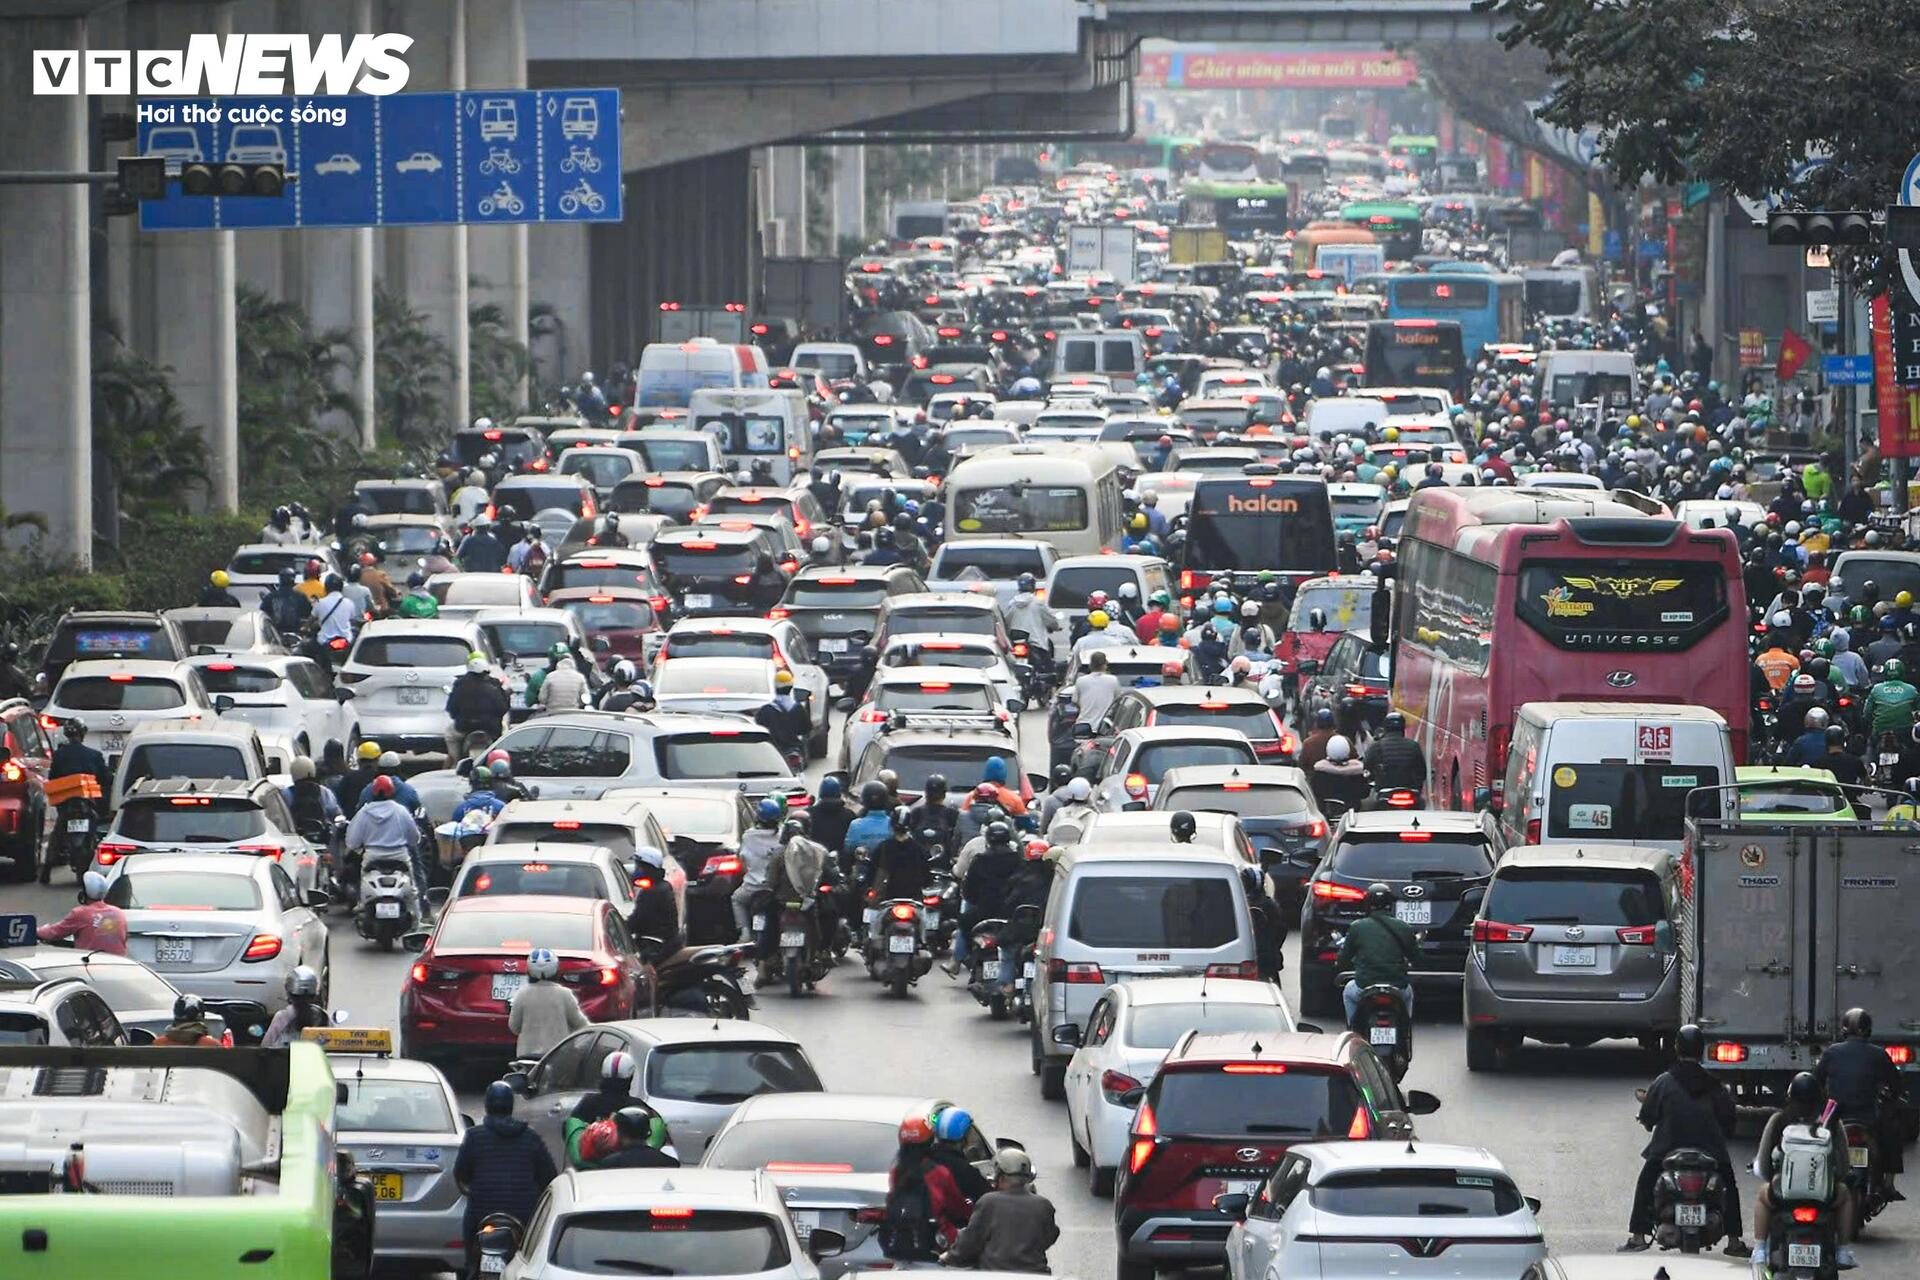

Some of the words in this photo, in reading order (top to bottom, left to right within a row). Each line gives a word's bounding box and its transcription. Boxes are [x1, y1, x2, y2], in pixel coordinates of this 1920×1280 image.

[1228, 494, 1299, 512] halan
[1609, 582, 1638, 591] VIP
[1564, 634, 1681, 644] UNIVERSE
[1883, 686, 1904, 694] Grab
[1591, 810, 1609, 827] 45
[1740, 877, 1778, 885] THACO
[1842, 878, 1896, 886] FRONTIER
